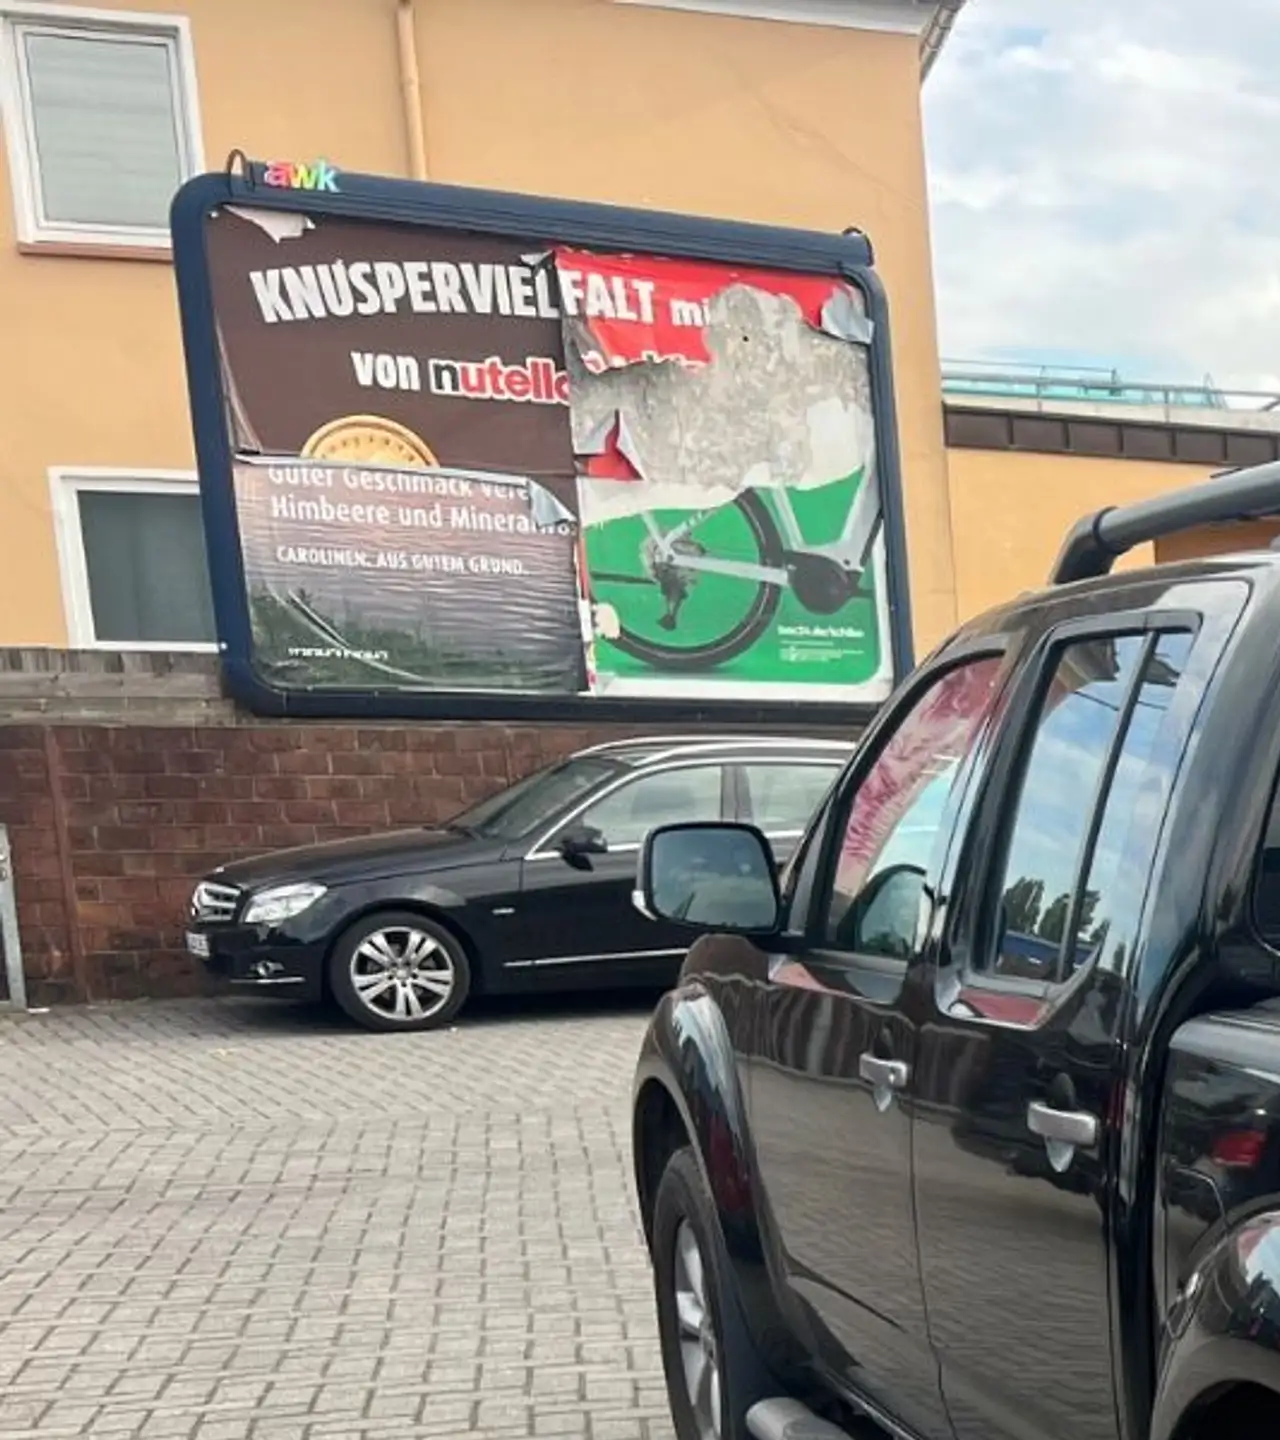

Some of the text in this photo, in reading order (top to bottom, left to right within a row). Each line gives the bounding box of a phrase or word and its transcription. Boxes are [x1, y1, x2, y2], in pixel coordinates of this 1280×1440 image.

[264, 159, 340, 193] awk
[249, 260, 655, 325] KNUSPERVIELFALT
[351, 351, 421, 392] von
[268, 466, 333, 487] Guter
[343, 468, 472, 497] Geschmack
[270, 494, 389, 525] Himbeere
[399, 502, 442, 527] und
[377, 551, 408, 569] AUS
